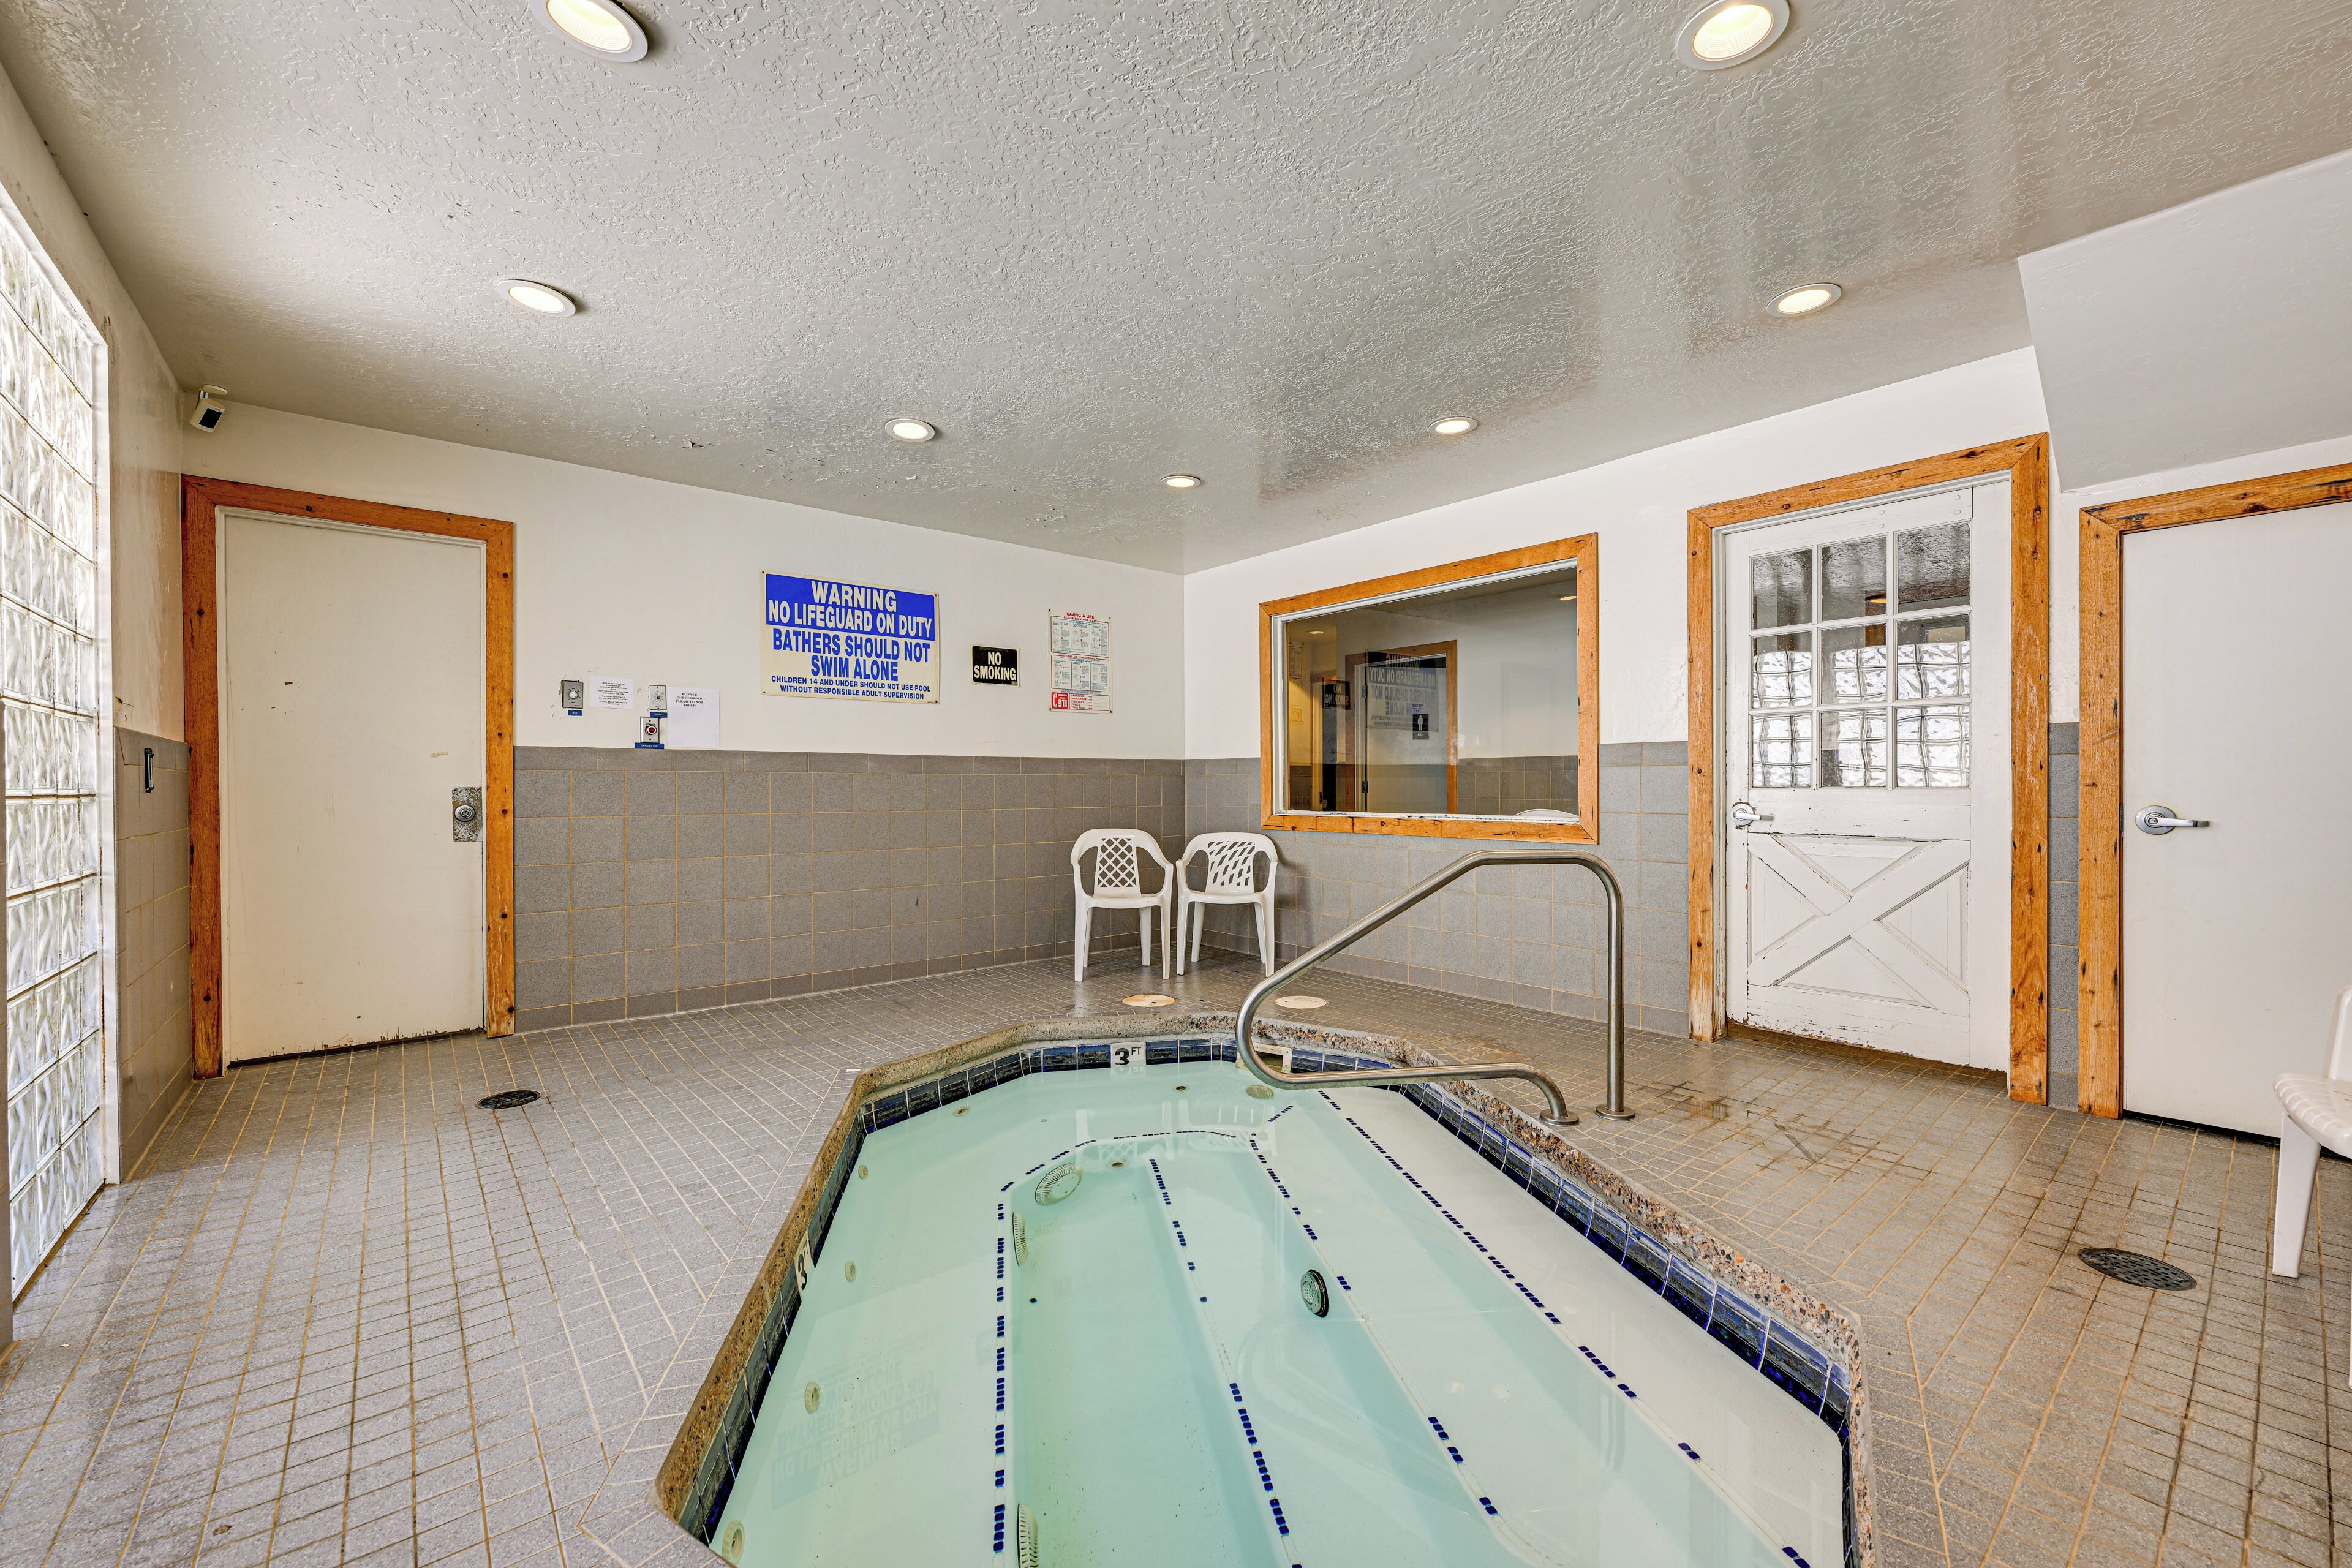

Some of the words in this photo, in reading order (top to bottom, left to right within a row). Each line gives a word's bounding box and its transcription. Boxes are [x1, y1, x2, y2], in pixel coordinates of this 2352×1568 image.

[811, 581, 897, 612] WARNING
[769, 600, 790, 624] NO
[794, 602, 873, 632] LIFEGUARD
[876, 612, 895, 634] ON
[899, 614, 932, 638] DUTY
[773, 628, 840, 655] BATHERS
[845, 635, 900, 660] SHOULD
[905, 641, 930, 663] NOT
[811, 655, 849, 678] SWIM
[854, 658, 898, 681] ALONE
[988, 652, 1001, 666] NO
[771, 676, 807, 684] CHILDREN
[974, 665, 1016, 681] SMOKING
[814, 687, 860, 696] RESPONSIBLE
[883, 691, 924, 699] SUPERVISION
[1058, 699, 1067, 708] 911
[1115, 1048, 1129, 1065] 3
[1131, 1047, 1141, 1055] FT
[798, 1253, 807, 1291] 3
